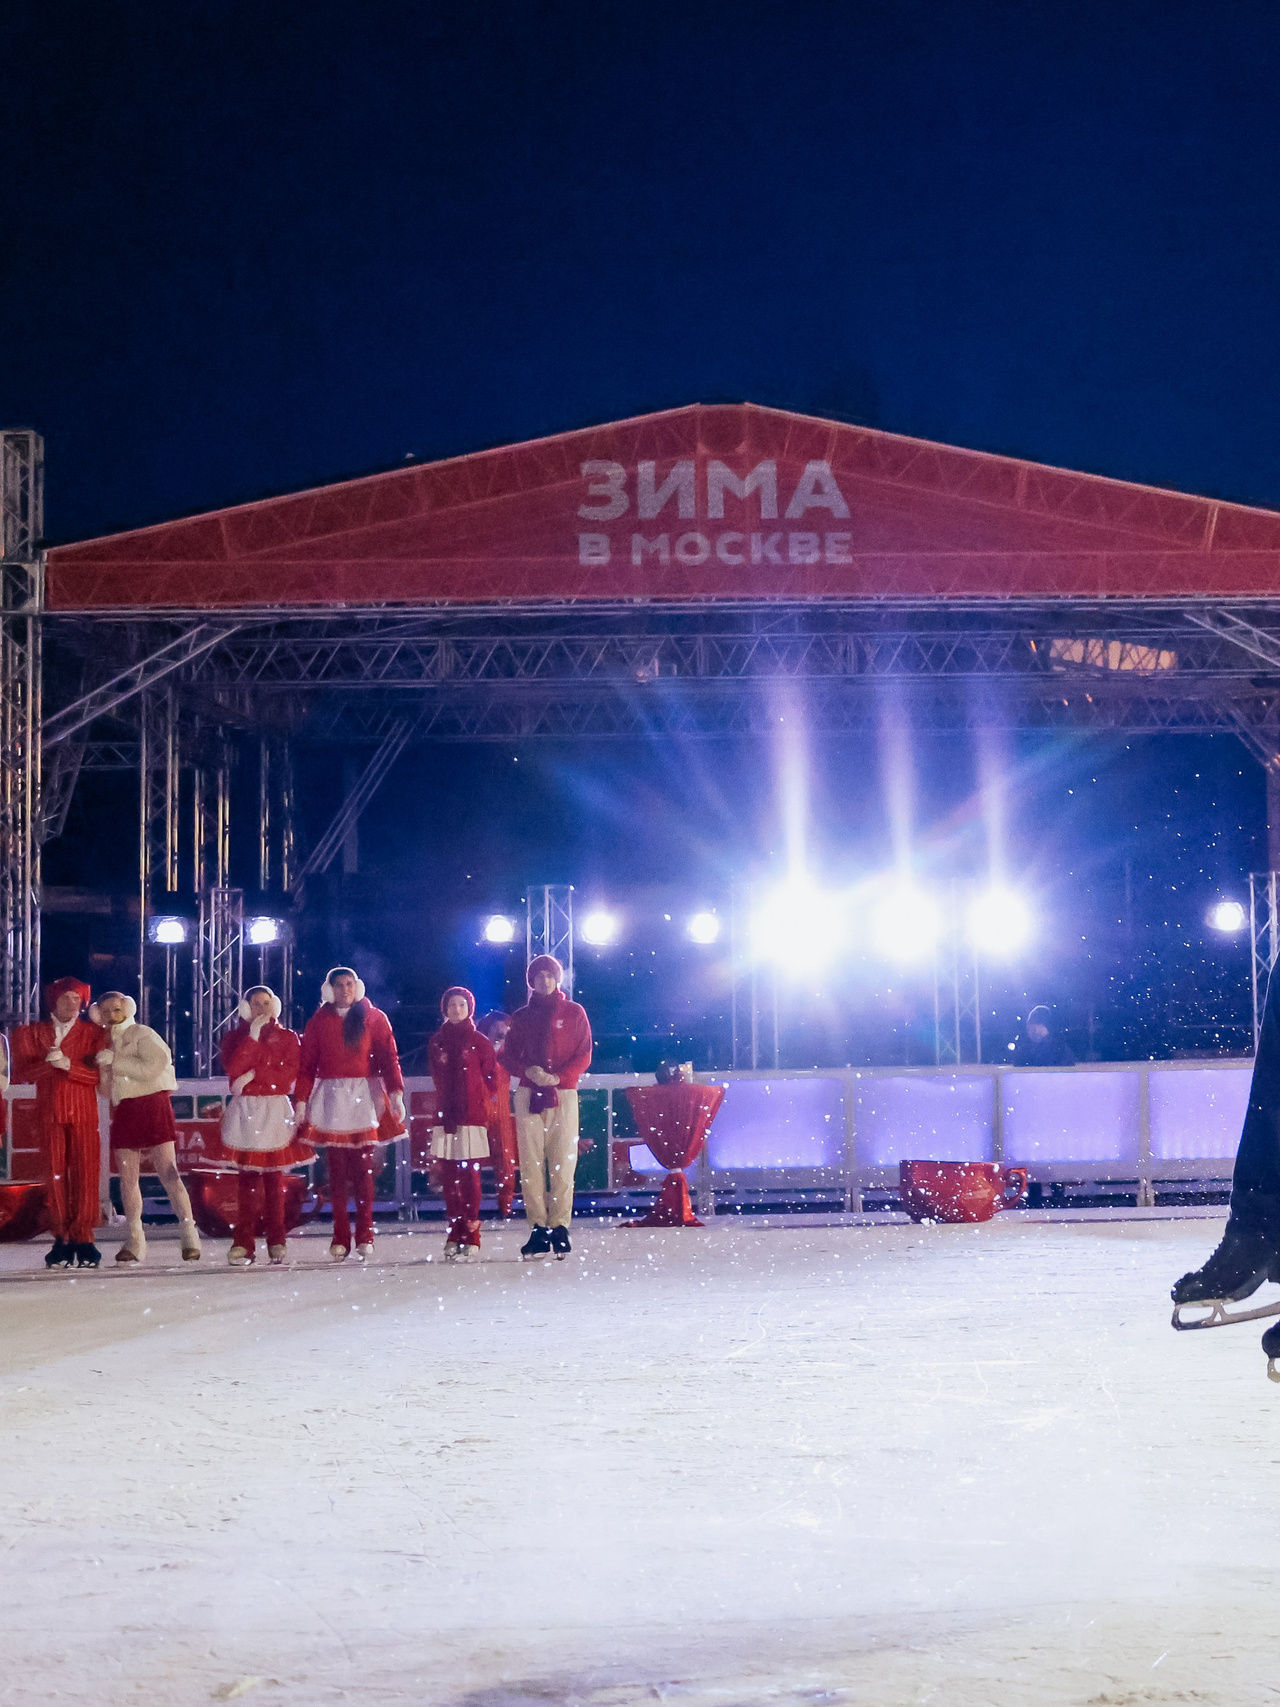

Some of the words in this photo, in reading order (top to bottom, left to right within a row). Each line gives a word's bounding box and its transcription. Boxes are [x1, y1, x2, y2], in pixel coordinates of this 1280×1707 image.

[577, 459, 851, 521] ЗИМА
[577, 532, 611, 566] В
[631, 531, 853, 566] МОСКВЕ
